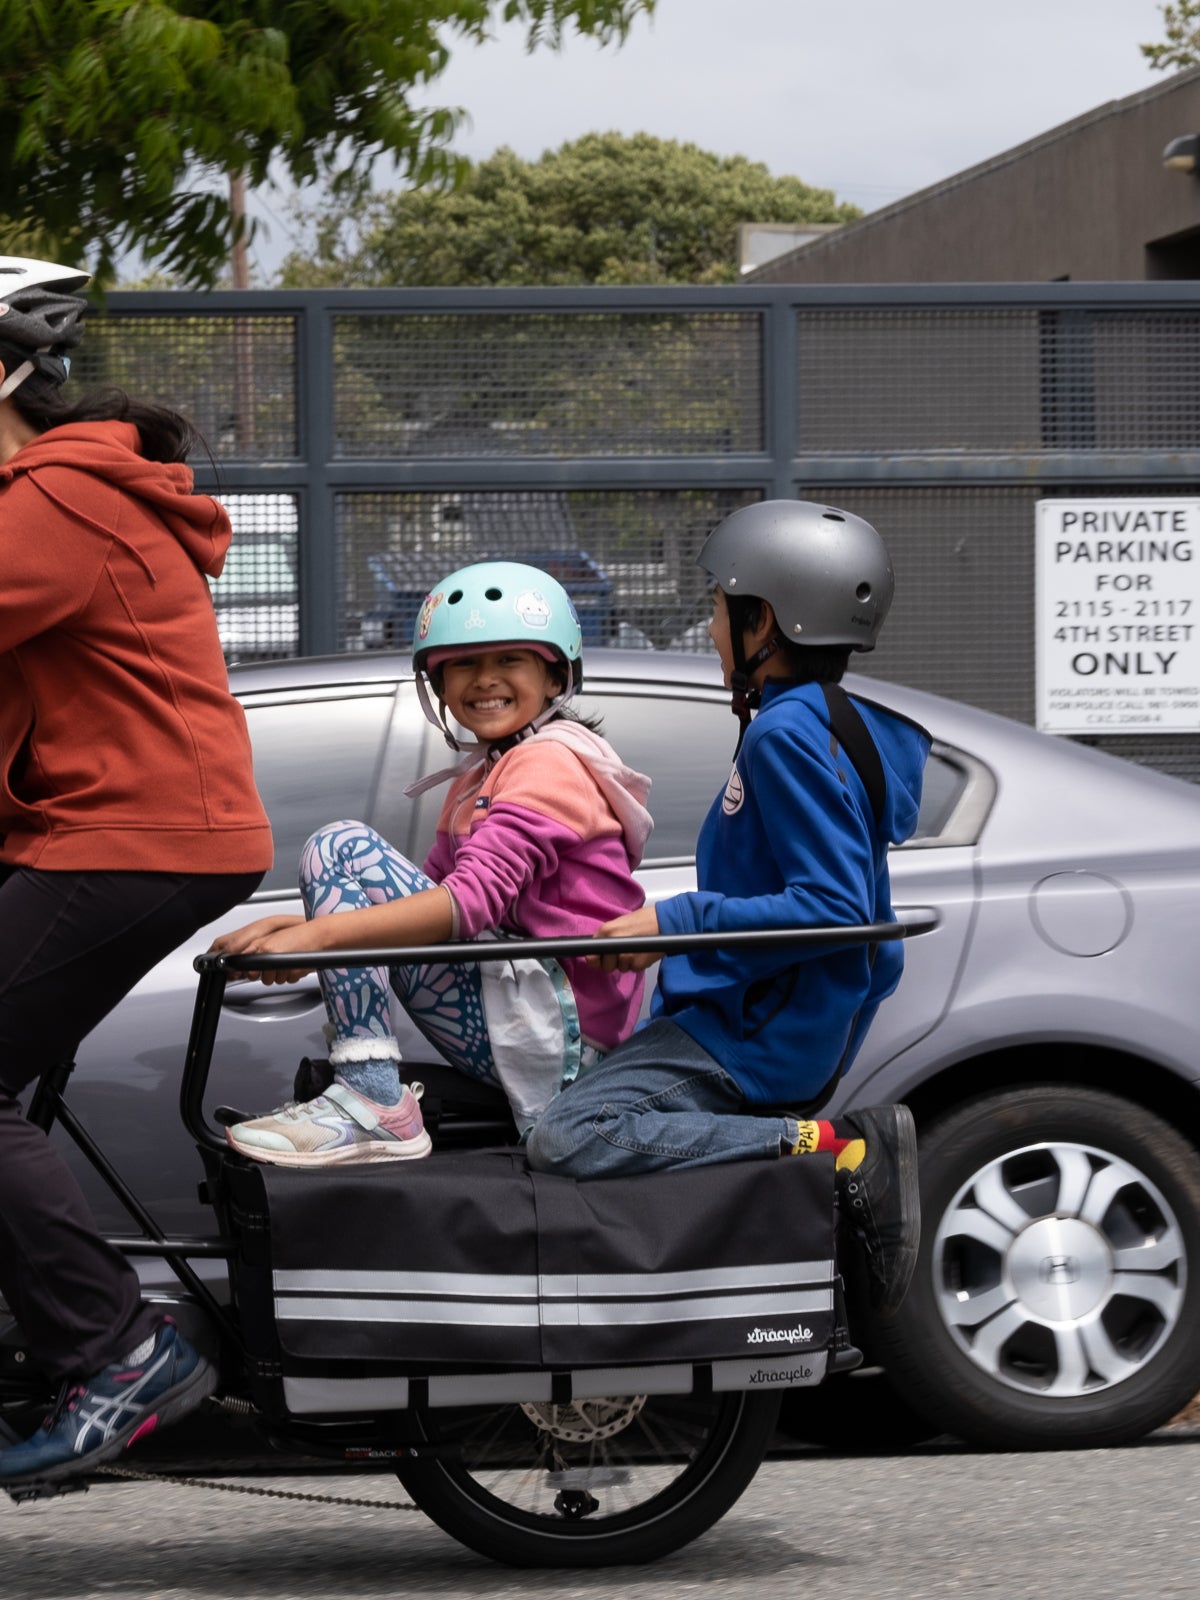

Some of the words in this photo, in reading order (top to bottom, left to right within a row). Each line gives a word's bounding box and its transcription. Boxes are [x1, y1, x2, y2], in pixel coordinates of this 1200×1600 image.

[1061, 511, 1188, 533] PRIVATE
[1055, 540, 1193, 563] PARKING
[1096, 574, 1152, 592] FOR
[1056, 600, 1112, 617] 2115
[1135, 599, 1193, 616] 2117
[1053, 626, 1100, 643] 4TH
[1107, 624, 1195, 642] STREET
[1071, 651, 1178, 676] ONLY
[747, 1323, 813, 1344] xtracycle
[749, 1365, 813, 1383] xtracycle
